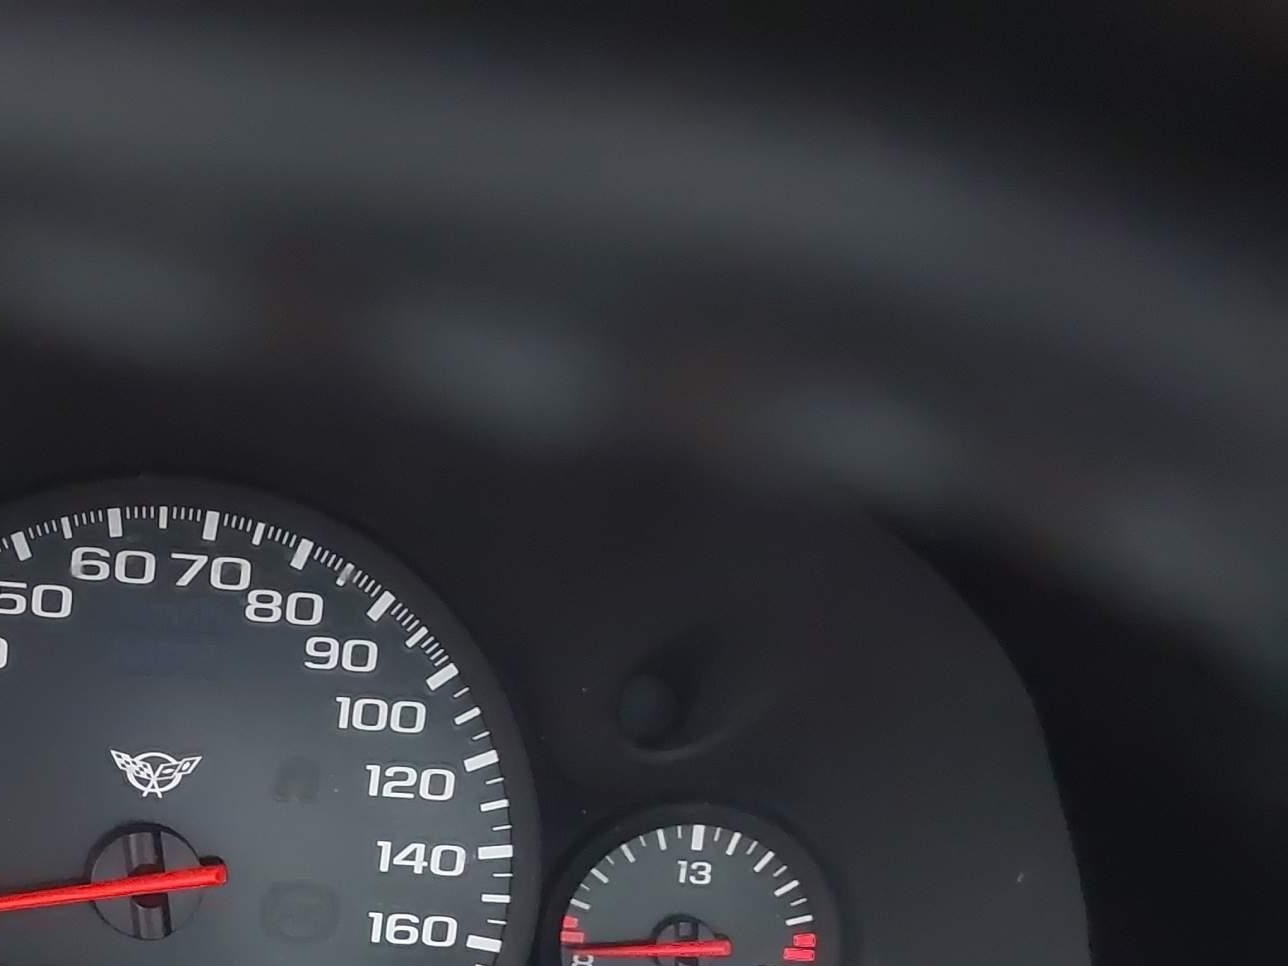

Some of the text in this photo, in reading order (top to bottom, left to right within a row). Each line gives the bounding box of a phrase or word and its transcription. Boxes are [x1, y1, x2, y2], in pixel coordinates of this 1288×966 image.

[70, 546, 156, 585] 60
[171, 553, 252, 592] 70
[244, 589, 324, 626] 80
[304, 636, 378, 672] 90
[335, 696, 426, 733] 100
[366, 764, 456, 801] 120
[377, 840, 466, 876] 140
[678, 860, 712, 885] 13
[368, 912, 458, 947] 160
